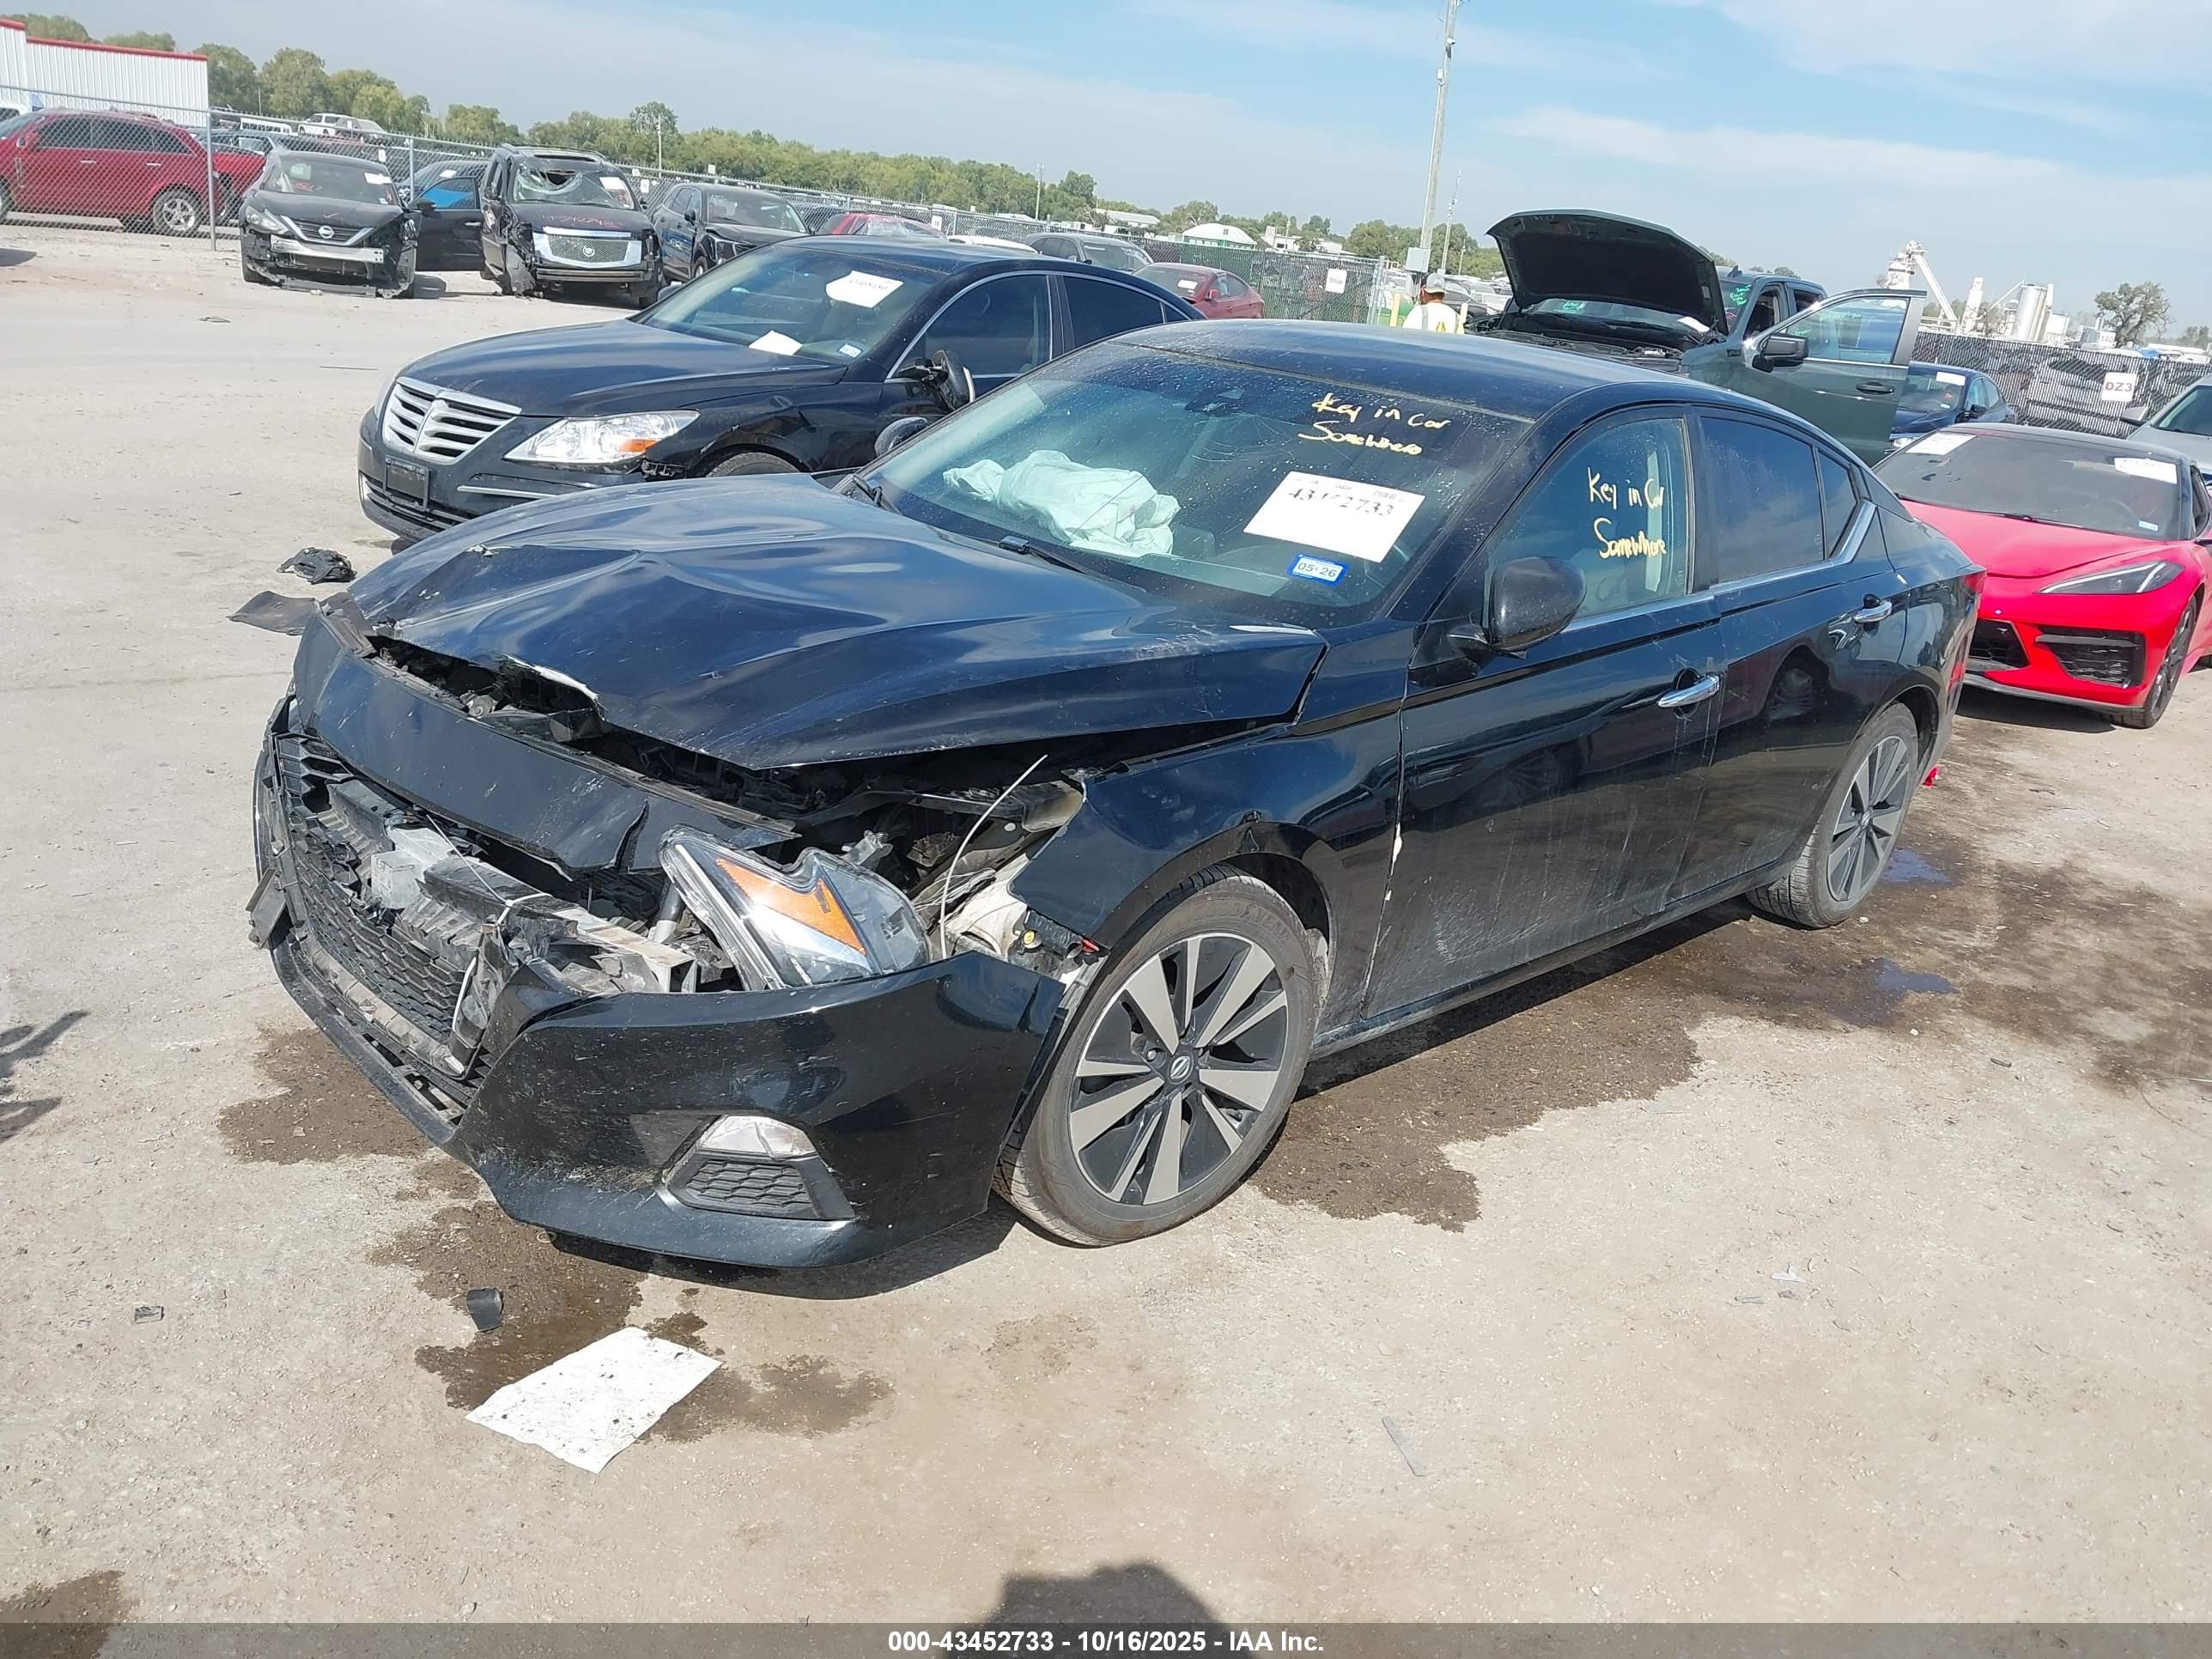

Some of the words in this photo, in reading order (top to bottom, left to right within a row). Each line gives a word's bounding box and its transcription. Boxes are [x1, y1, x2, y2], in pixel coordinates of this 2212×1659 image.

[1311, 392, 1363, 423] Key
[1373, 404, 1401, 420] in
[1587, 466, 1618, 511] Key
[1626, 478, 1643, 507] in
